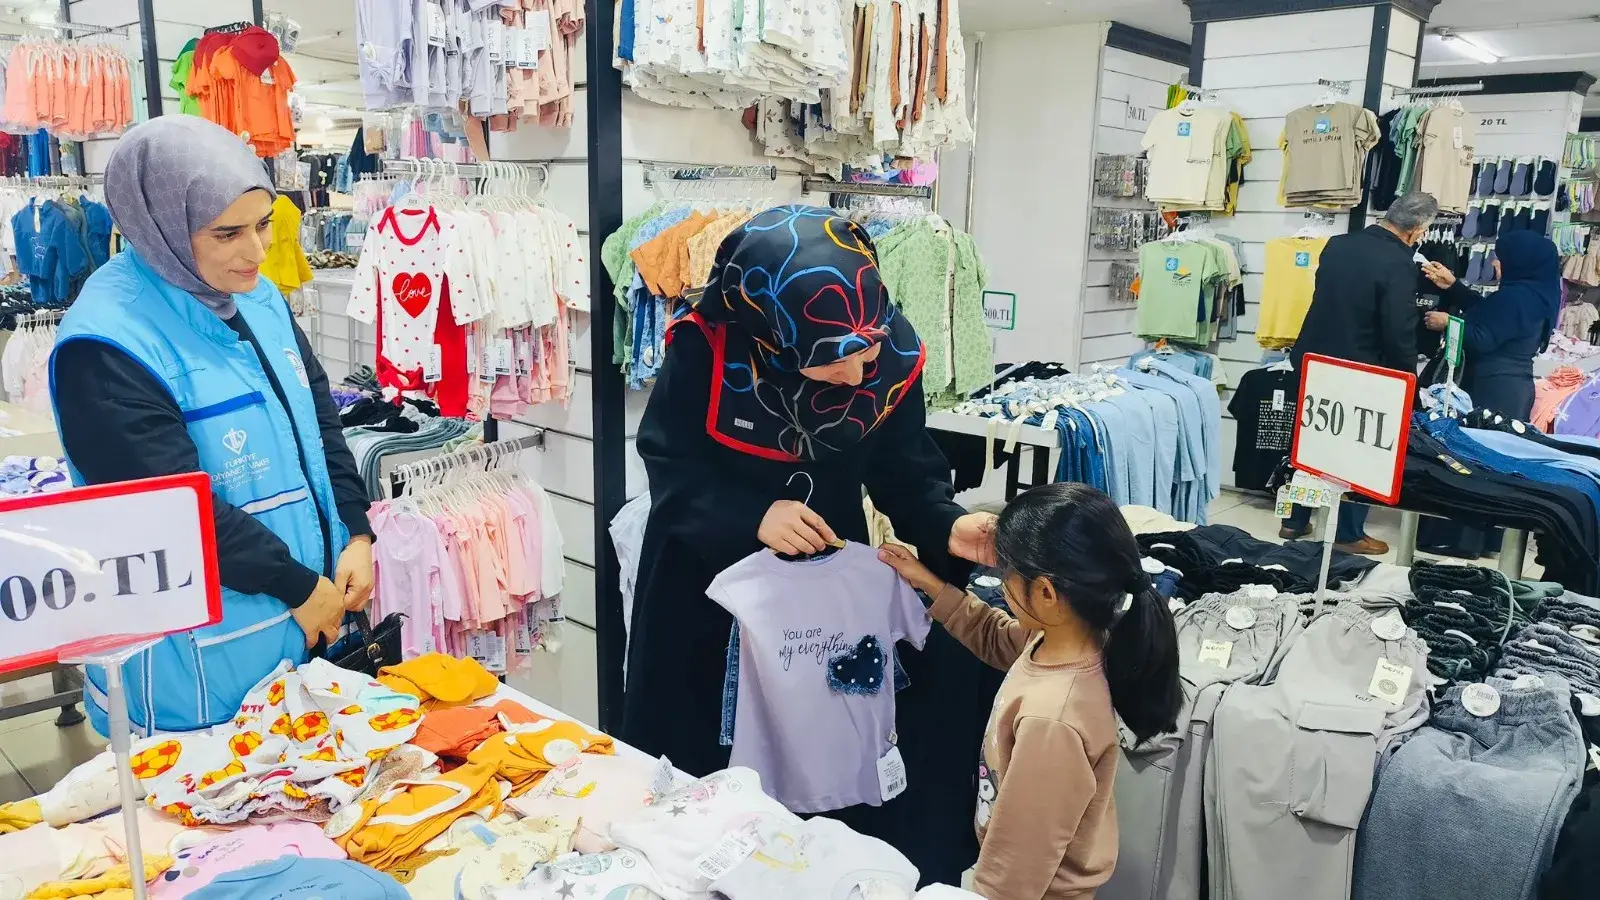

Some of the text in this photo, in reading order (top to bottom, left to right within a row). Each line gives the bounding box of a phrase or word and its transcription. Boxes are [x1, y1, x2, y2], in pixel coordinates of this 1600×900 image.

[1128, 106, 1147, 121] 30.TL
[1480, 118, 1493, 126] 20
[394, 278, 432, 302] love
[1300, 394, 1344, 436] 350
[1354, 405, 1395, 452] TL
[782, 627, 822, 641] You are
[779, 644, 795, 672] my
